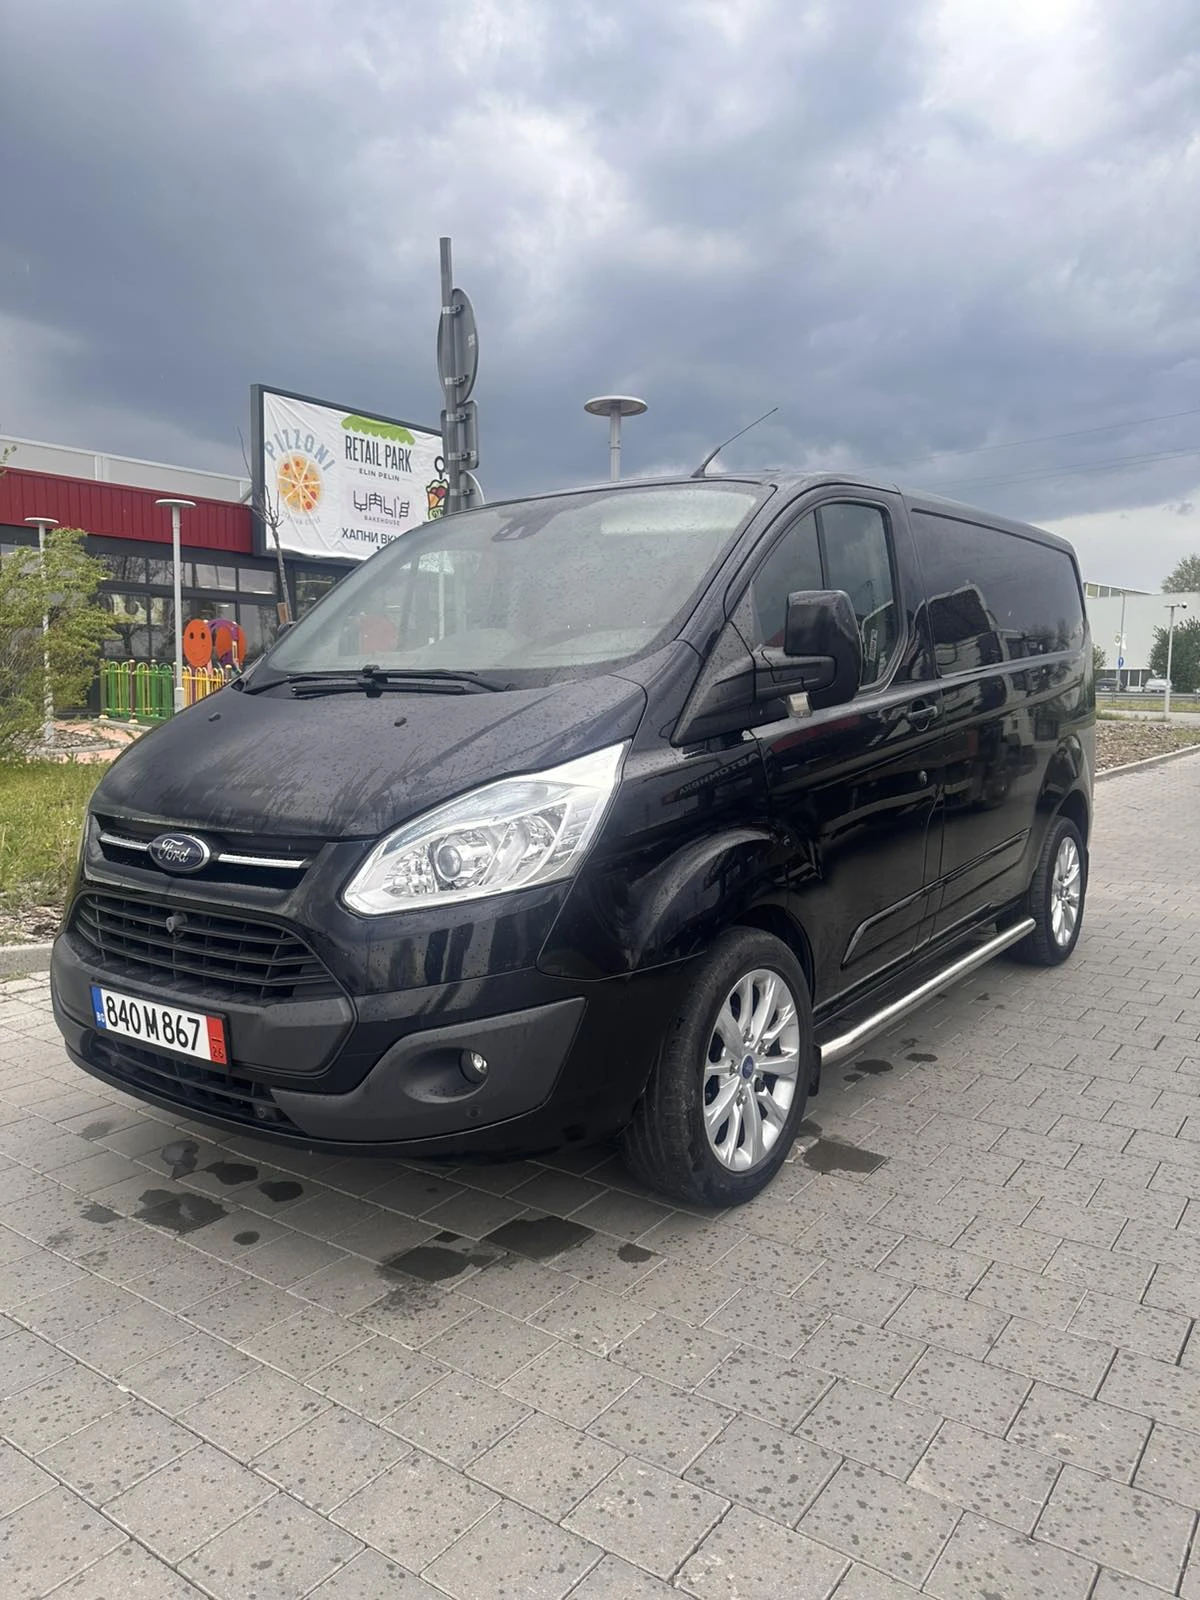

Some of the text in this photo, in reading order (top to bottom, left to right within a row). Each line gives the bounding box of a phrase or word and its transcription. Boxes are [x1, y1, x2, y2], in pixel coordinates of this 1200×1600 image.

[265, 429, 336, 472] PIZZONI
[345, 434, 413, 473] RETAIL PARK
[358, 467, 400, 483] ELIN PELIN
[364, 515, 401, 526] BAKEHOUSE
[341, 527, 379, 544] ХАПНИ
[157, 838, 190, 863] Ford
